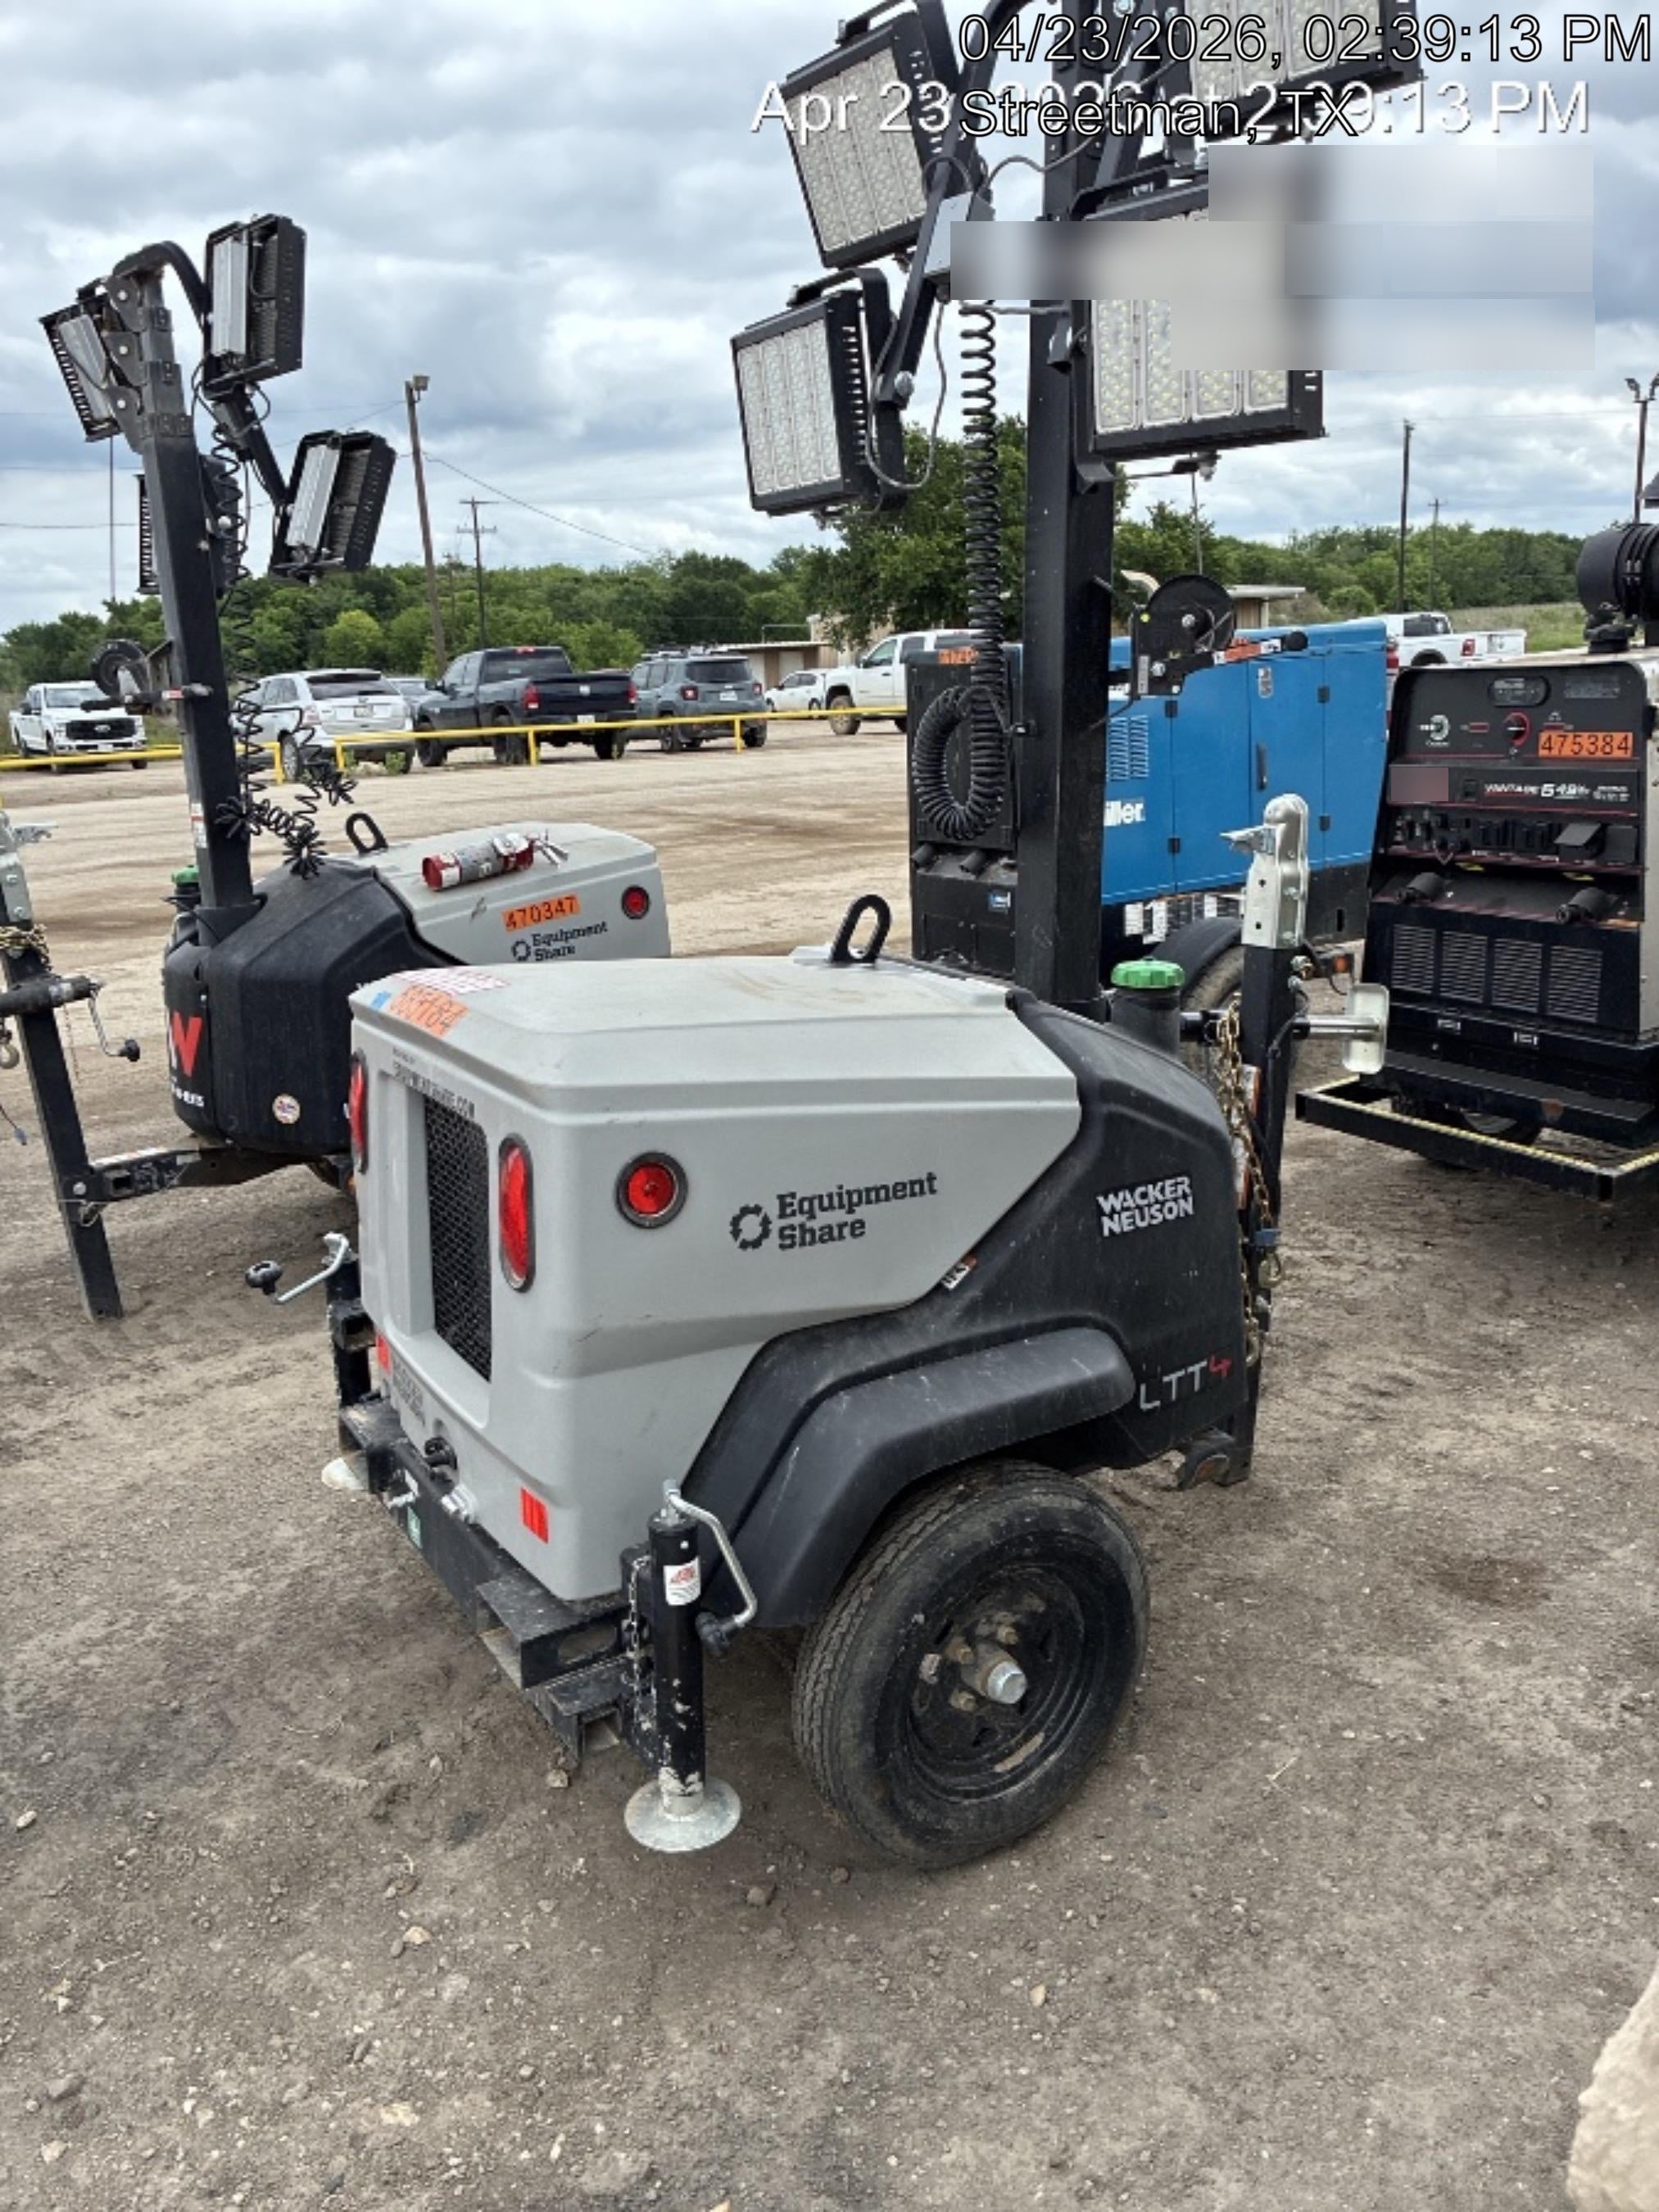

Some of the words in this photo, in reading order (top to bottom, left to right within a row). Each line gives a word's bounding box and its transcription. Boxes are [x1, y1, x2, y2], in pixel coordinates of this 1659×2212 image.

[1539, 734, 1630, 755] 475384
[1103, 800, 1146, 827] iller
[505, 894, 576, 930] 470347
[531, 921, 609, 947] Equipment
[534, 945, 576, 962] Share
[777, 1172, 937, 1221] Equipment
[1096, 1176, 1191, 1215] WACKER
[1100, 1194, 1195, 1237] NEUSON
[778, 1217, 866, 1251] Share
